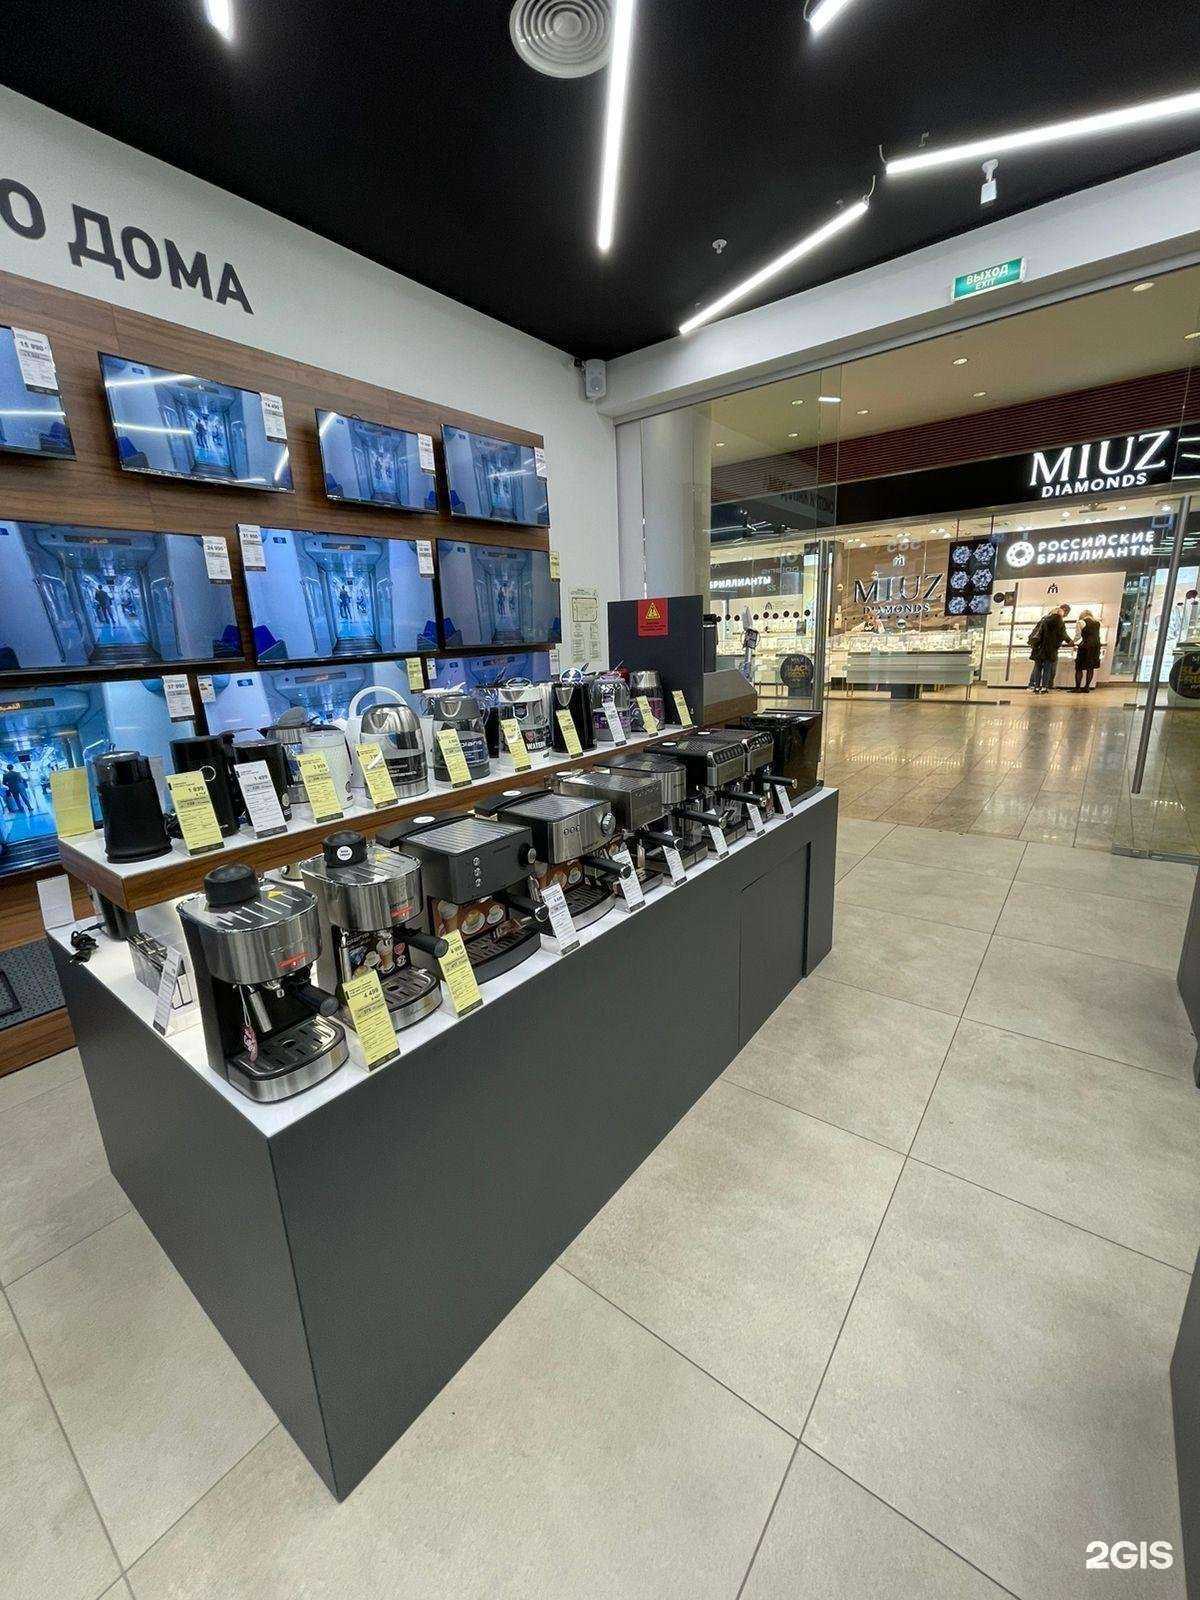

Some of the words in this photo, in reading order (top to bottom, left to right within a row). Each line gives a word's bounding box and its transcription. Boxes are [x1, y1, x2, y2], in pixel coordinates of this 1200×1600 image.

[67, 203, 255, 316] ДОМА
[966, 264, 1009, 285] ВЫХОД
[975, 279, 995, 290] EXIT
[1029, 430, 1170, 487] MIUZ
[1041, 472, 1147, 498] DIAMONDS
[1038, 530, 1155, 552] РОССИЙСКИЕ
[1036, 544, 1154, 566] БРИЛЛИАНТЫ
[853, 572, 945, 604] MIUZ
[863, 603, 931, 615] DIAMONDS
